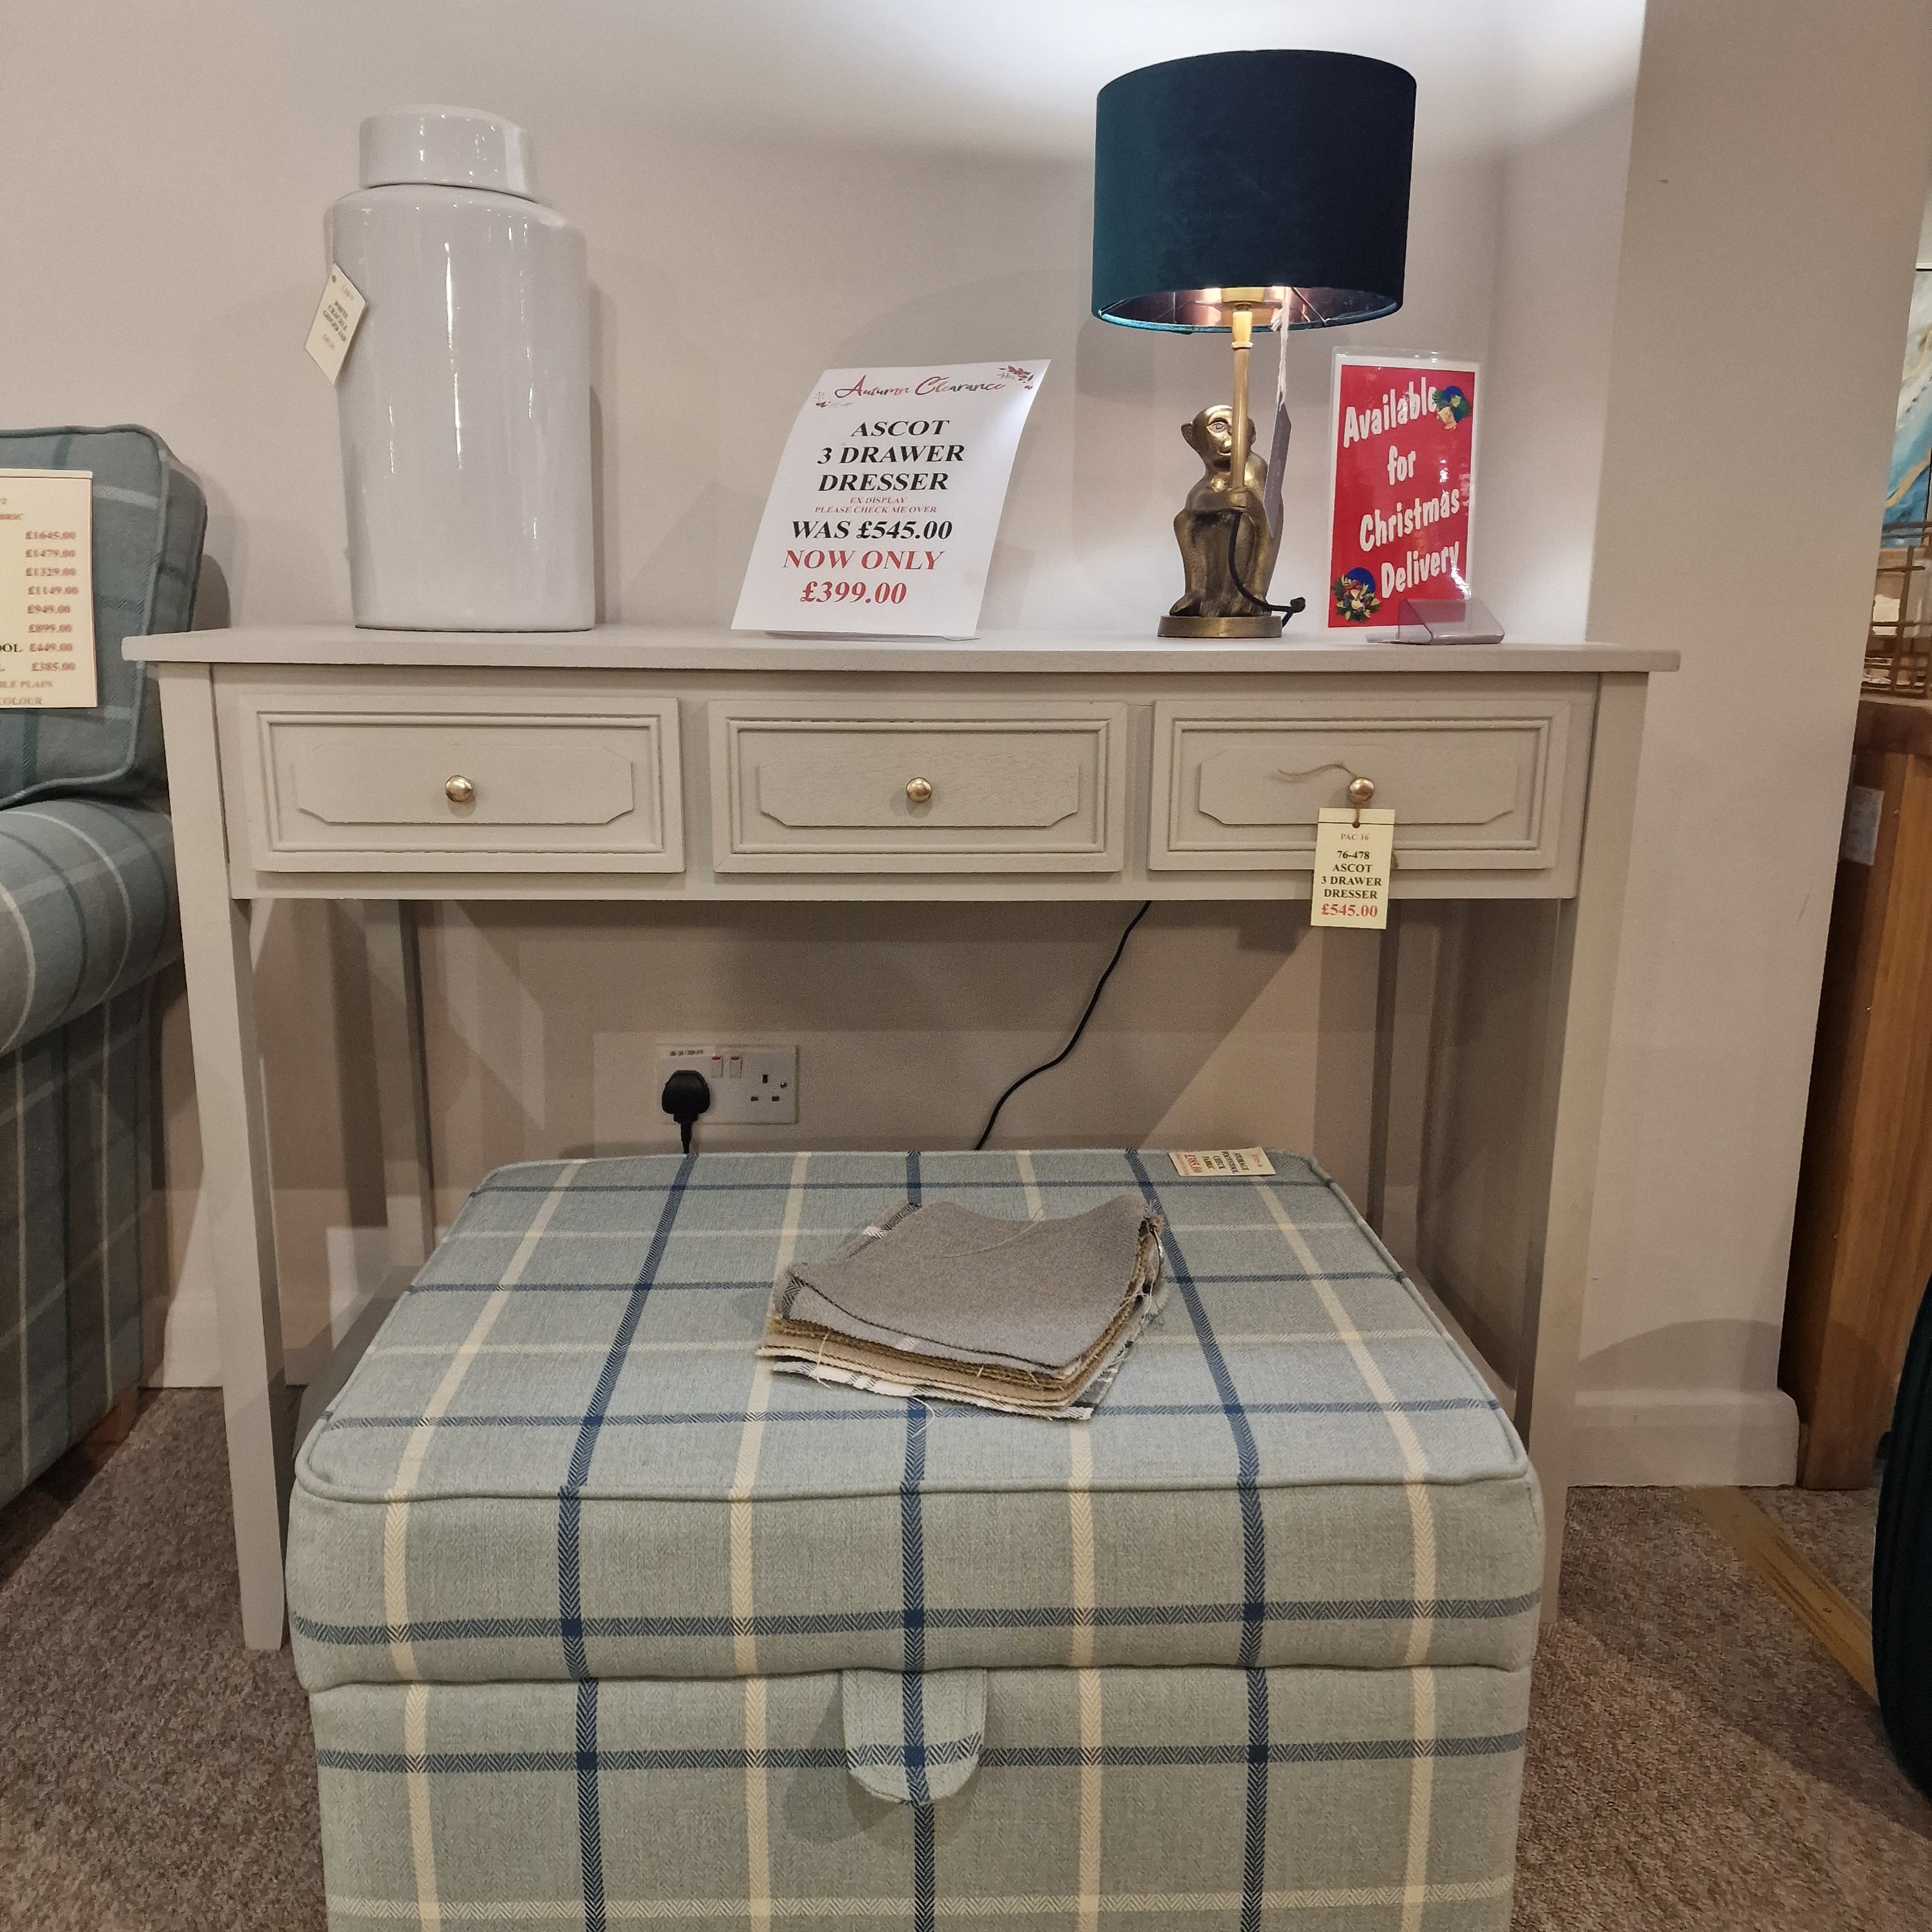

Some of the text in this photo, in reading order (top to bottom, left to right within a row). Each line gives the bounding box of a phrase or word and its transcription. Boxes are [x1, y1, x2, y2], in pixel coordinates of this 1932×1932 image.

[834, 375, 1006, 398] Autumn Clearance
[1342, 376, 1438, 447] Available
[850, 420, 950, 437] ASCOT
[817, 444, 965, 464] 3 DRAWER
[1387, 444, 1417, 486] for
[817, 473, 949, 491] DRESSER
[865, 496, 907, 504] DISPLAY
[1359, 488, 1460, 552] Christmas
[792, 520, 952, 539] WAS £545.00
[782, 550, 945, 570] NOW ONLY
[1381, 540, 1459, 599] Delivery
[800, 581, 907, 604] £399.00
[0, 643, 22, 652] OL
[1337, 850, 1370, 859] 76-478
[1332, 863, 1373, 872] ASCOT
[1330, 876, 1381, 886] DRAWER
[1324, 889, 1378, 899] DRESSER
[1321, 903, 1378, 918] £545.00
